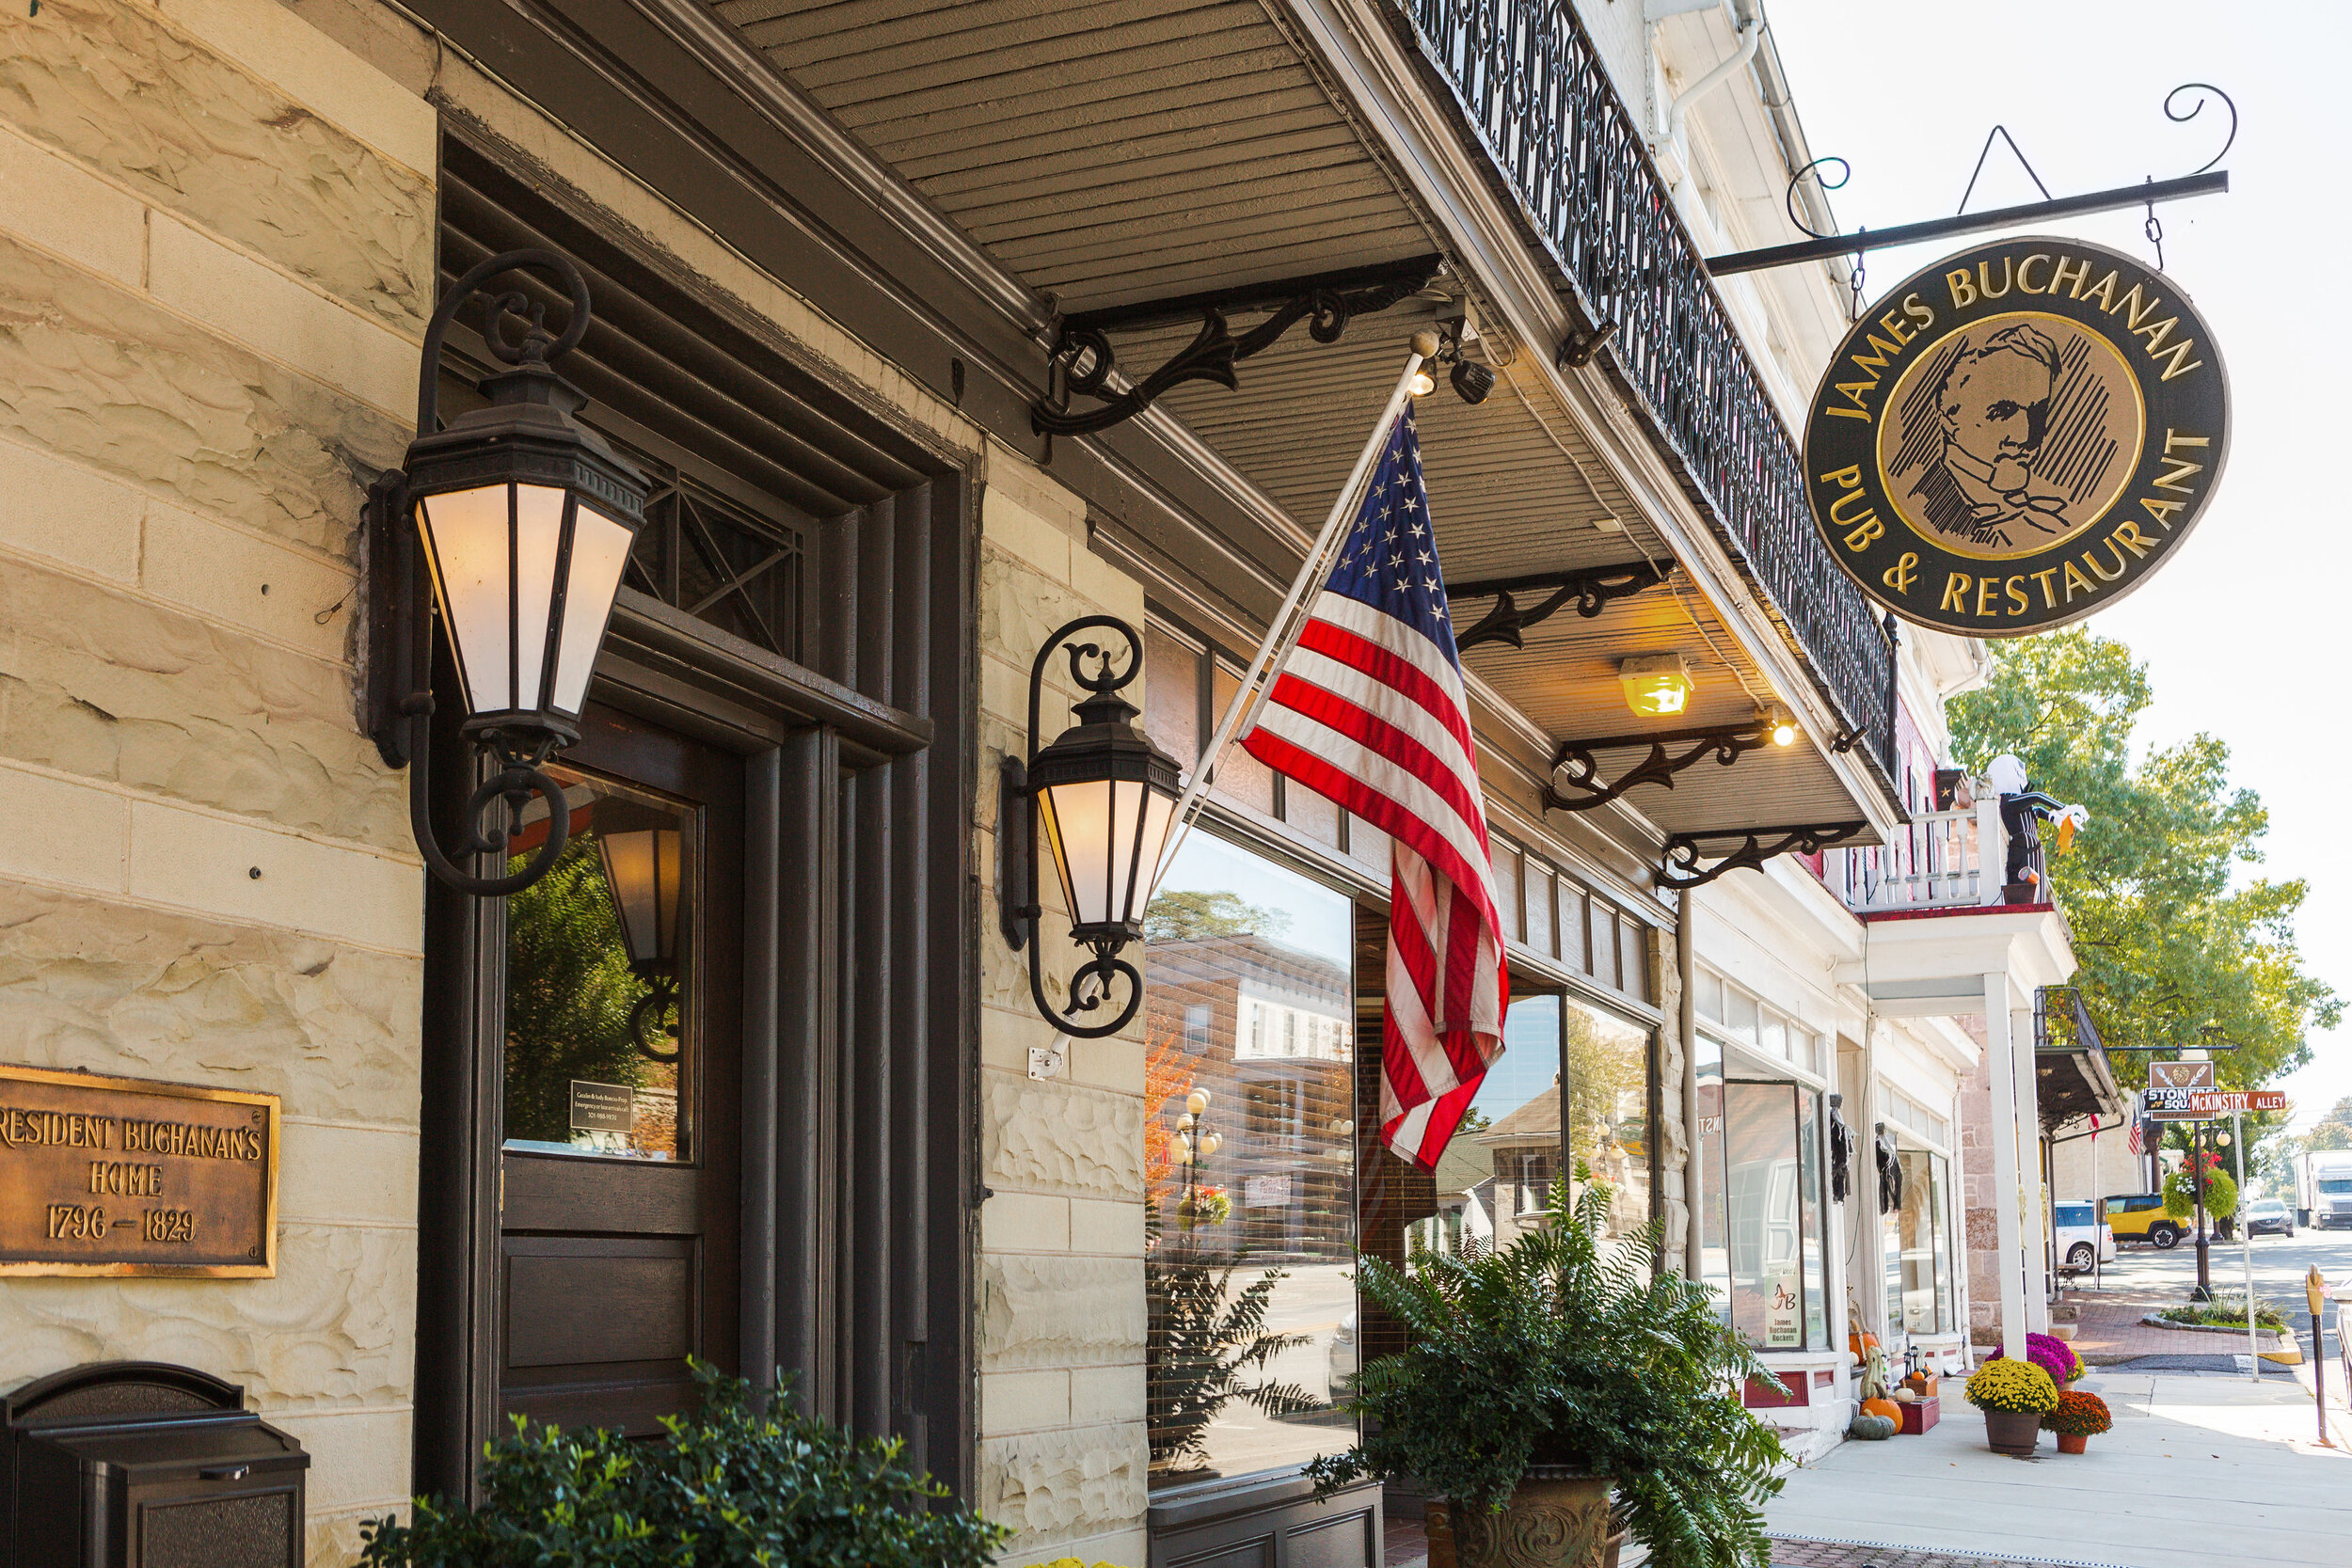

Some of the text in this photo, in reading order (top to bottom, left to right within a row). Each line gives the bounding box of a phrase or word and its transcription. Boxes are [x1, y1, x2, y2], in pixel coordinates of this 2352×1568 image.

[1826, 254, 2203, 423] JAMES BUCHANAN
[1820, 428, 2211, 617] PUB & RESTAURANT
[575, 1101, 596, 1110] Emergency
[2191, 1093, 2284, 1112] McKINSTRY ALLEY
[123, 1119, 262, 1161] BUCHANAN'S
[90, 1161, 163, 1196] HOME
[48, 1206, 107, 1240] 1796
[144, 1209, 196, 1242] 1829
